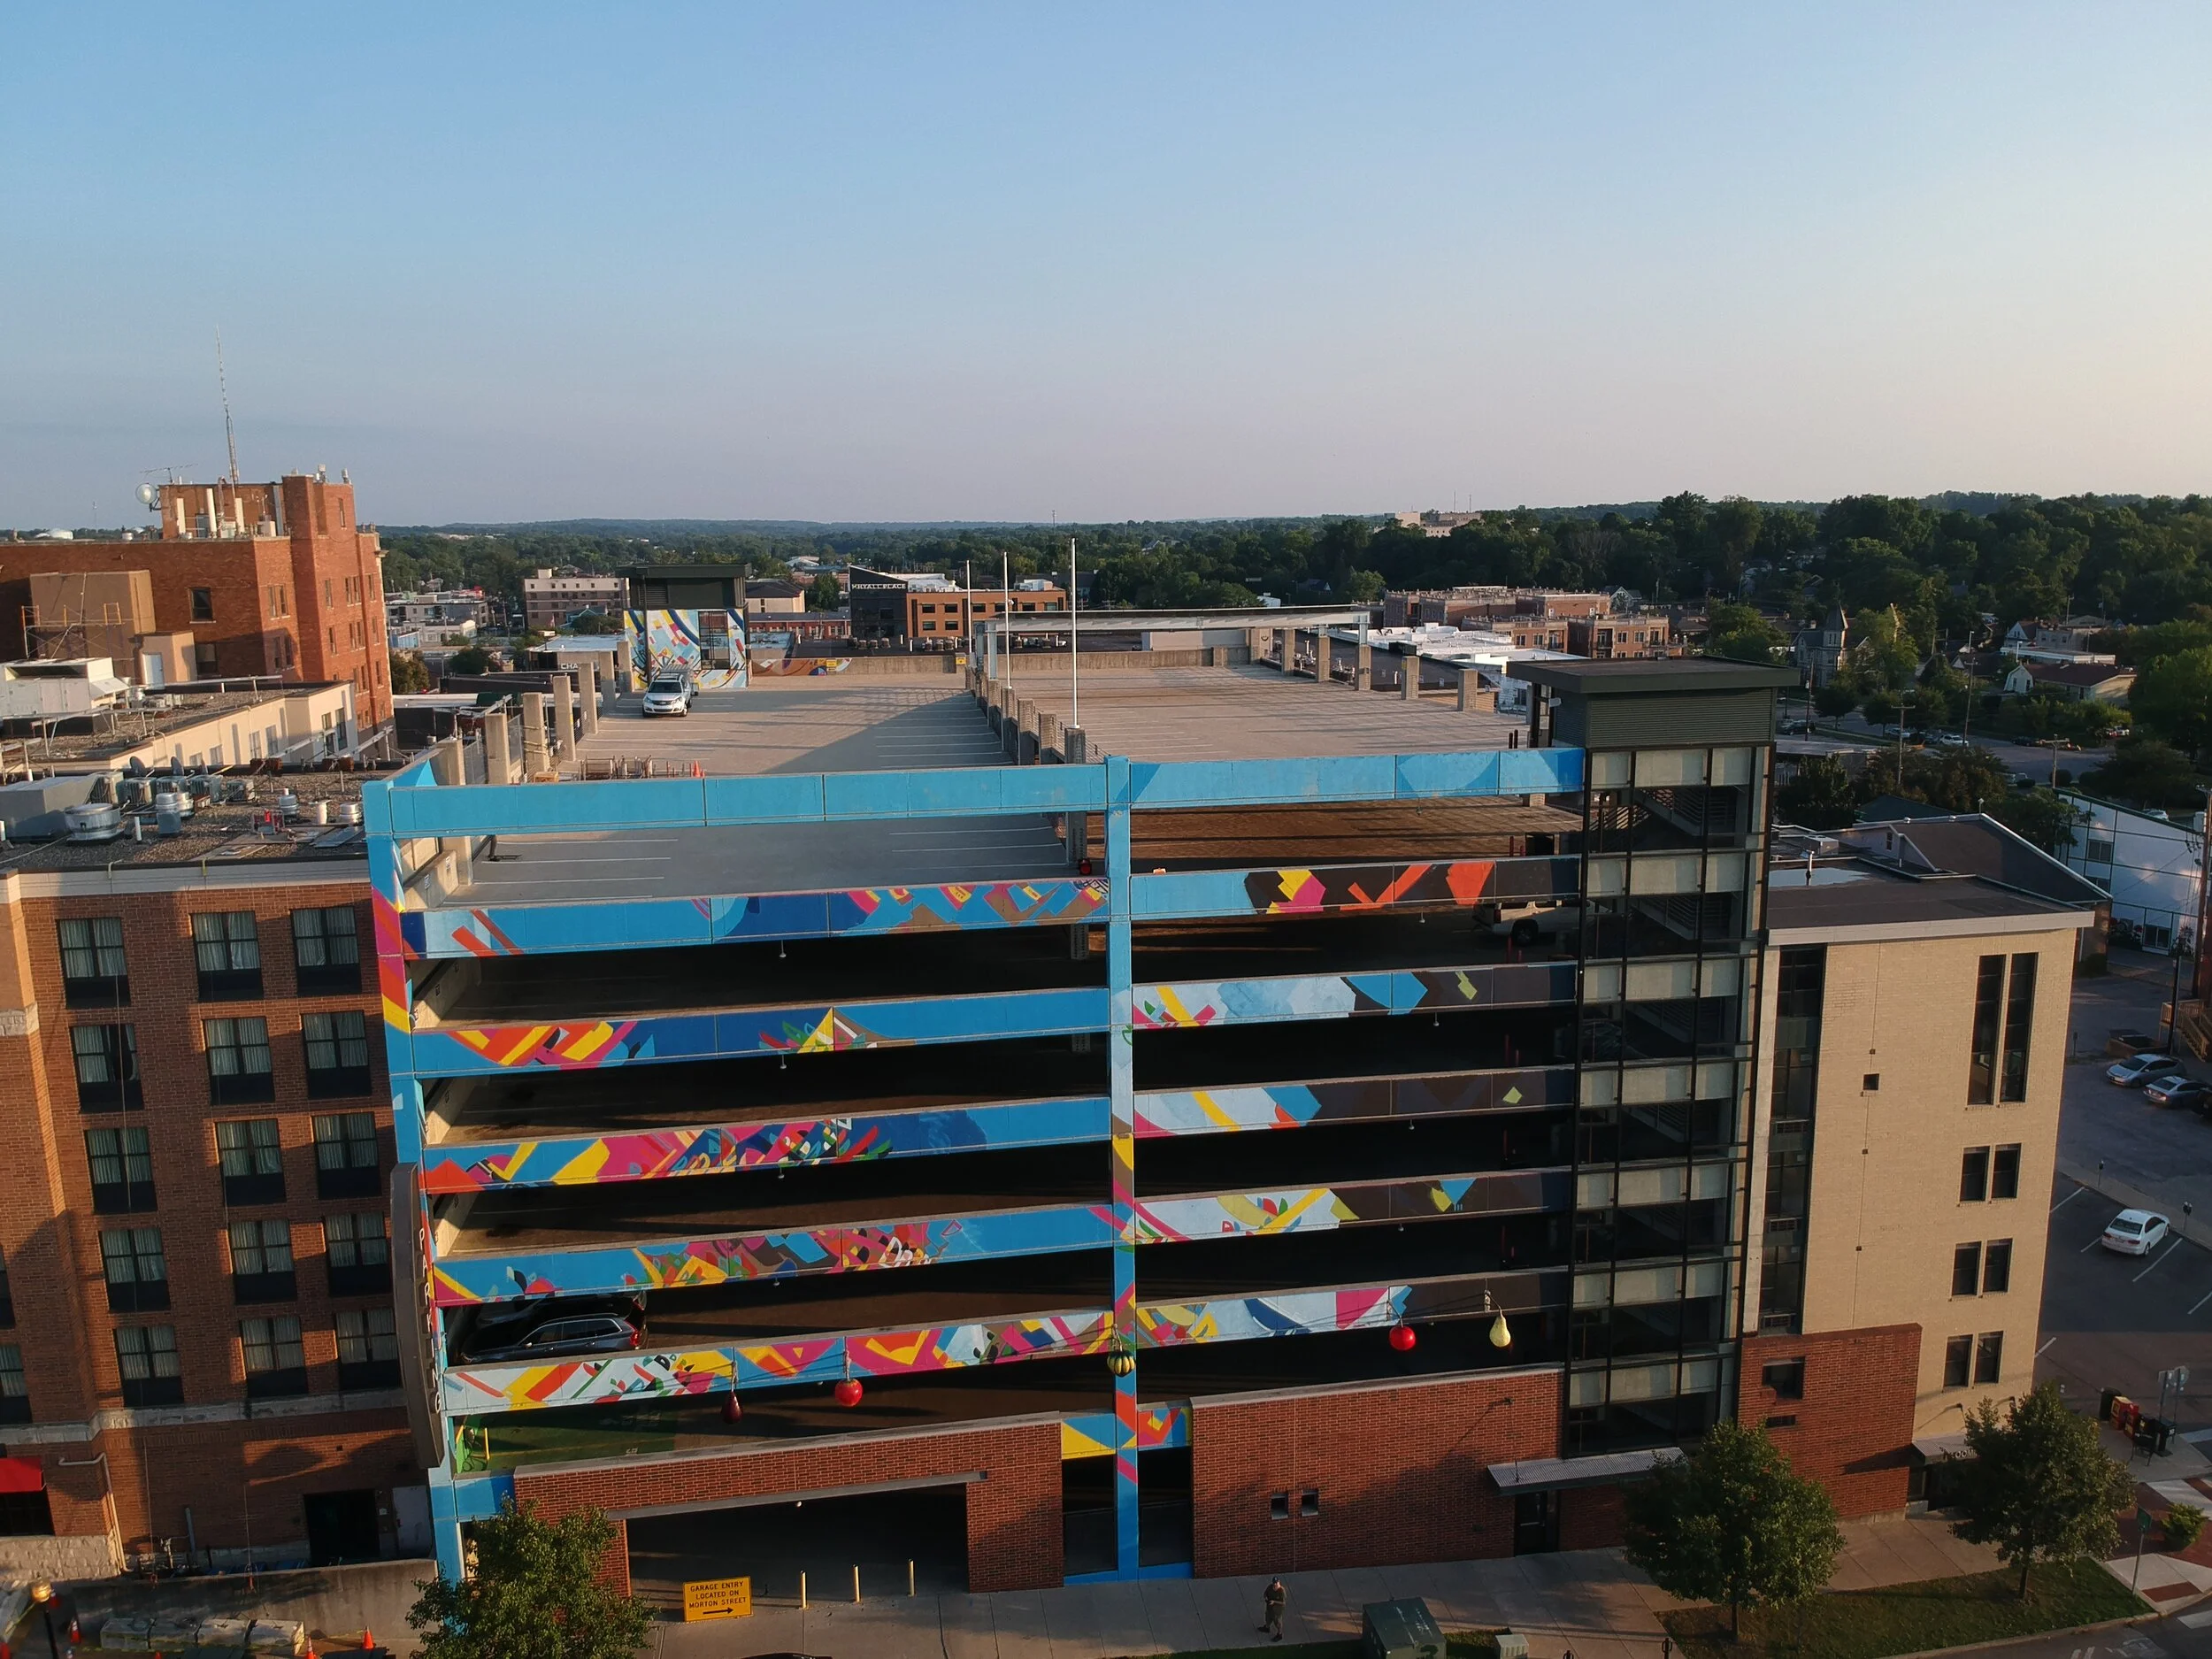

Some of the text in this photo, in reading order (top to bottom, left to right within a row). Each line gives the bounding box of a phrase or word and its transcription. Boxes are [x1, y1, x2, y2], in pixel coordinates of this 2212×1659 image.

[419, 1228, 442, 1414] PARKING
[690, 1580, 744, 1592] GARAGE ENTRY
[695, 1591, 726, 1600] LOCATED
[688, 1596, 747, 1609] MORTON STREET
